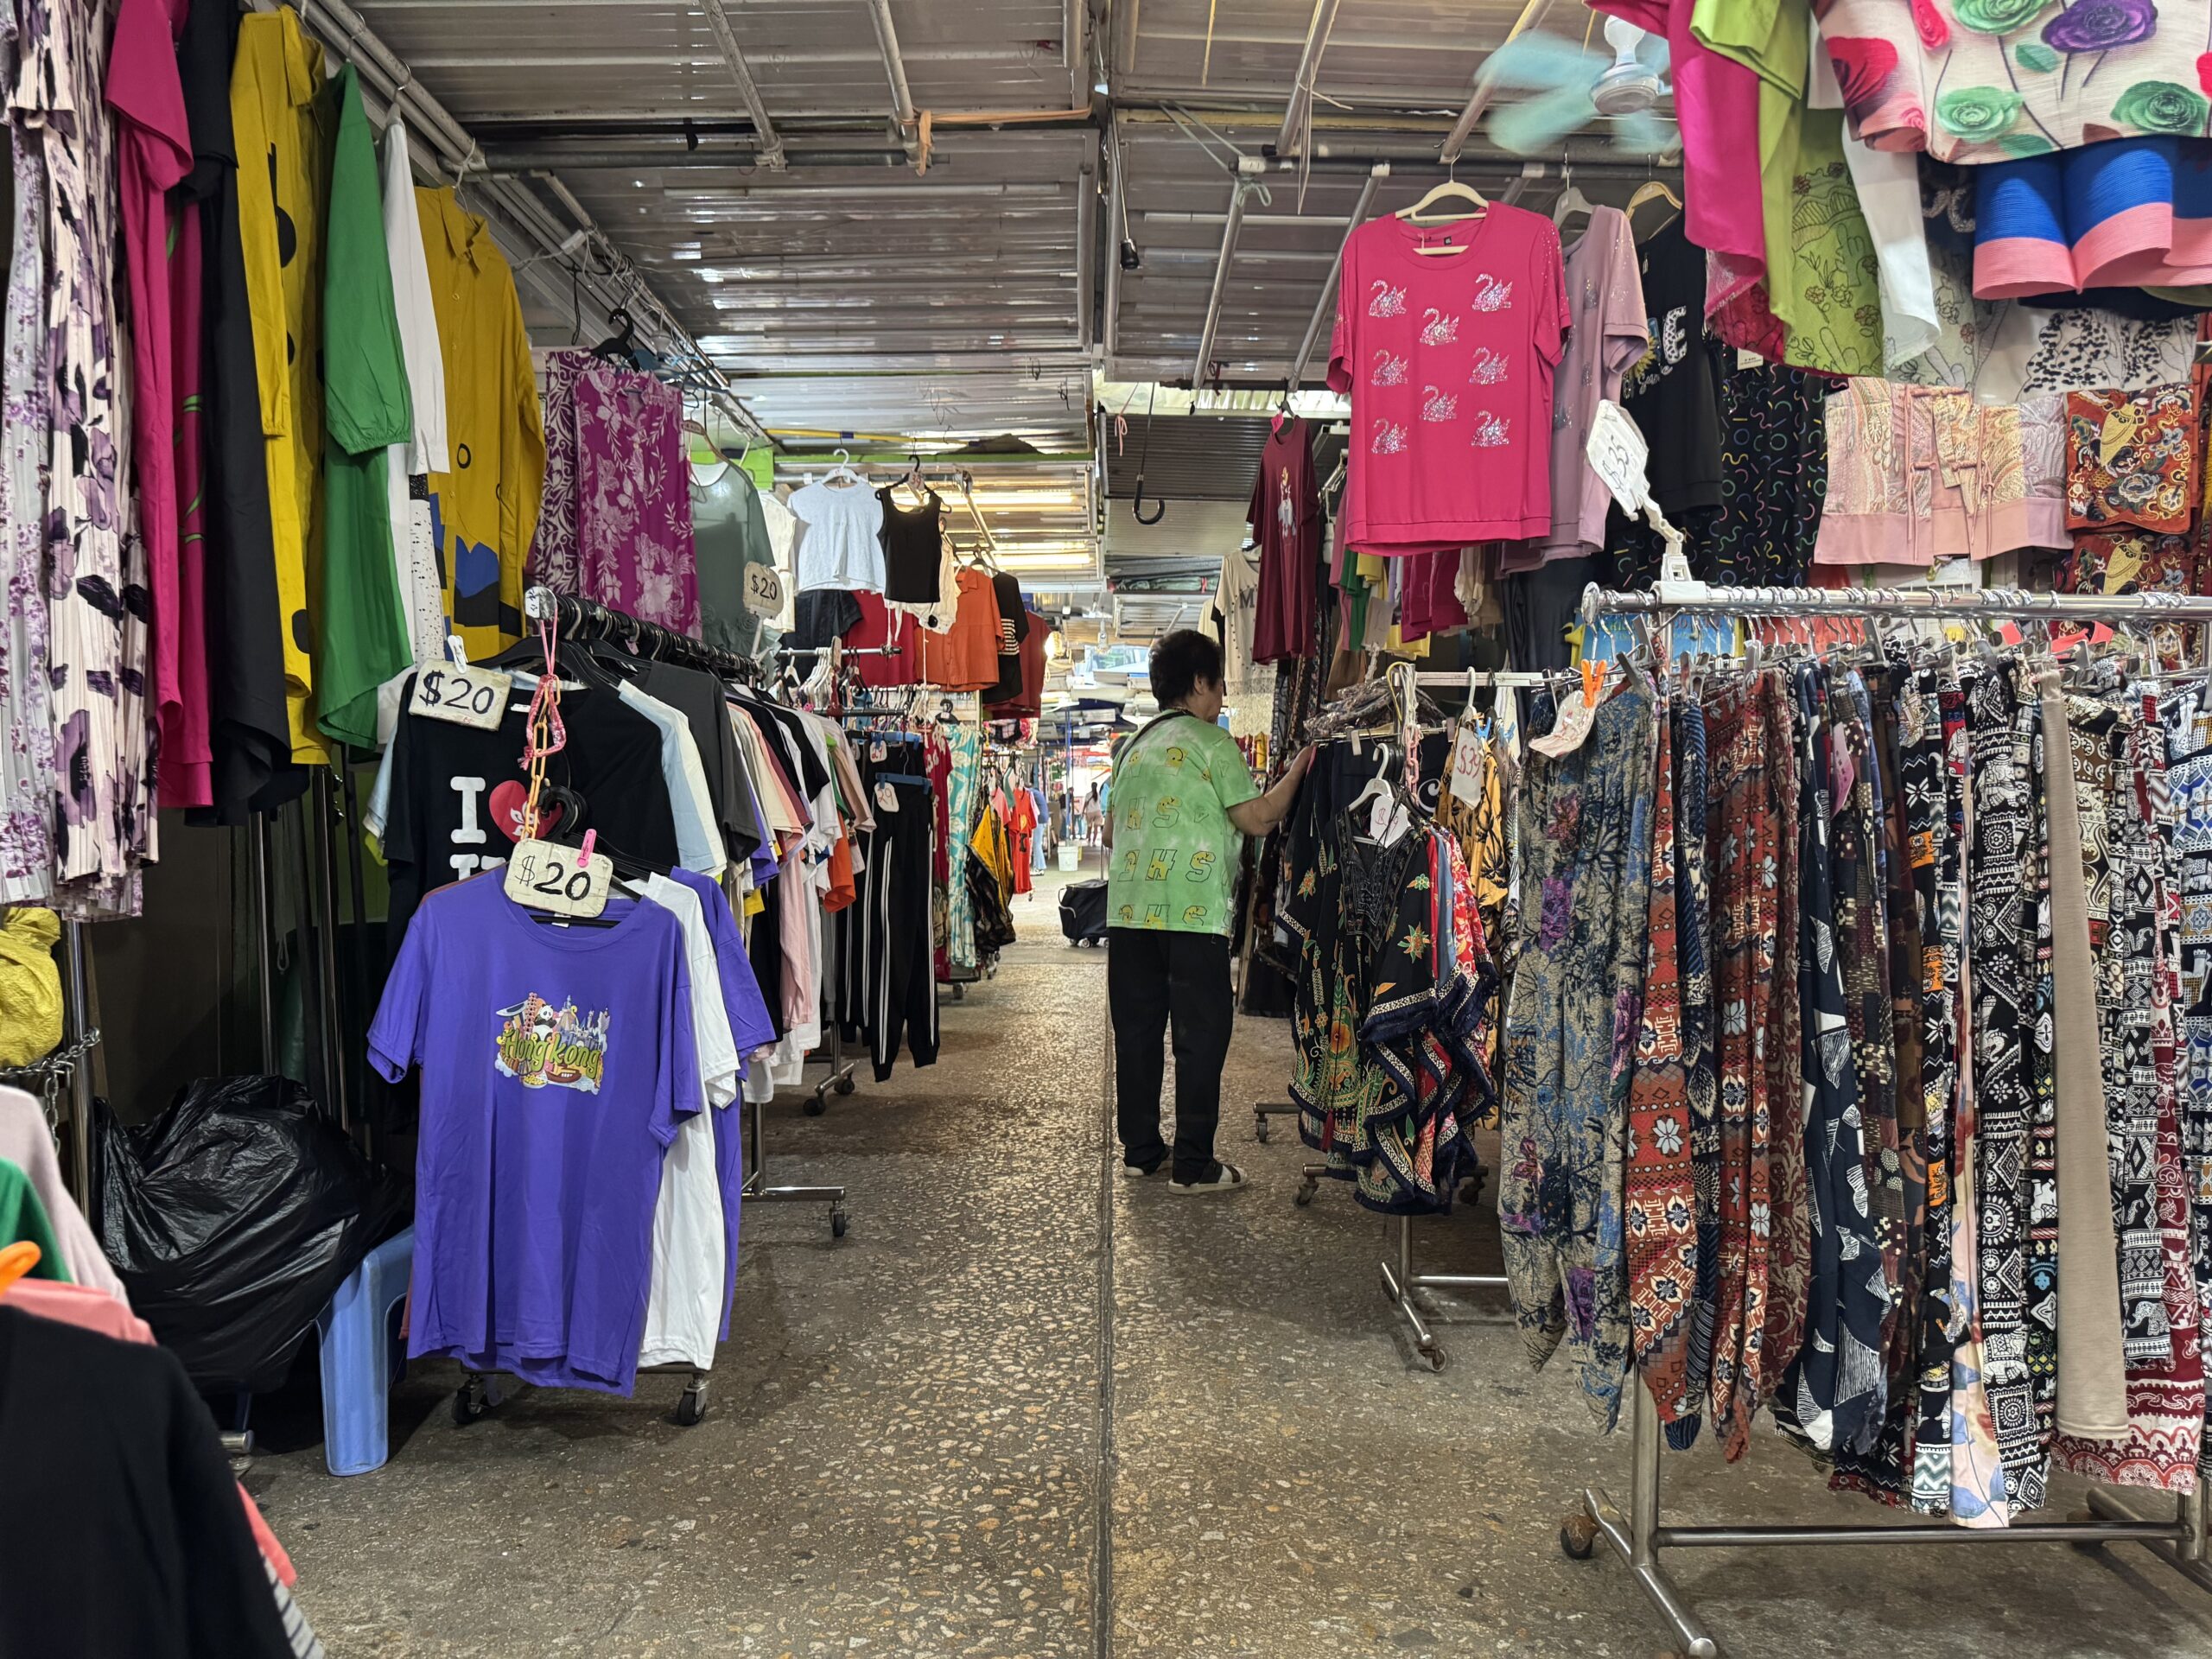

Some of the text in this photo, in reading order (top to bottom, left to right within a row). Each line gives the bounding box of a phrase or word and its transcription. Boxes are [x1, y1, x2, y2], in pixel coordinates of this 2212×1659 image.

[750, 573, 778, 601] $20
[419, 669, 494, 715] $20
[1457, 744, 1481, 778] $39
[450, 776, 487, 844] I
[877, 787, 894, 807] 29
[515, 855, 591, 901] $20
